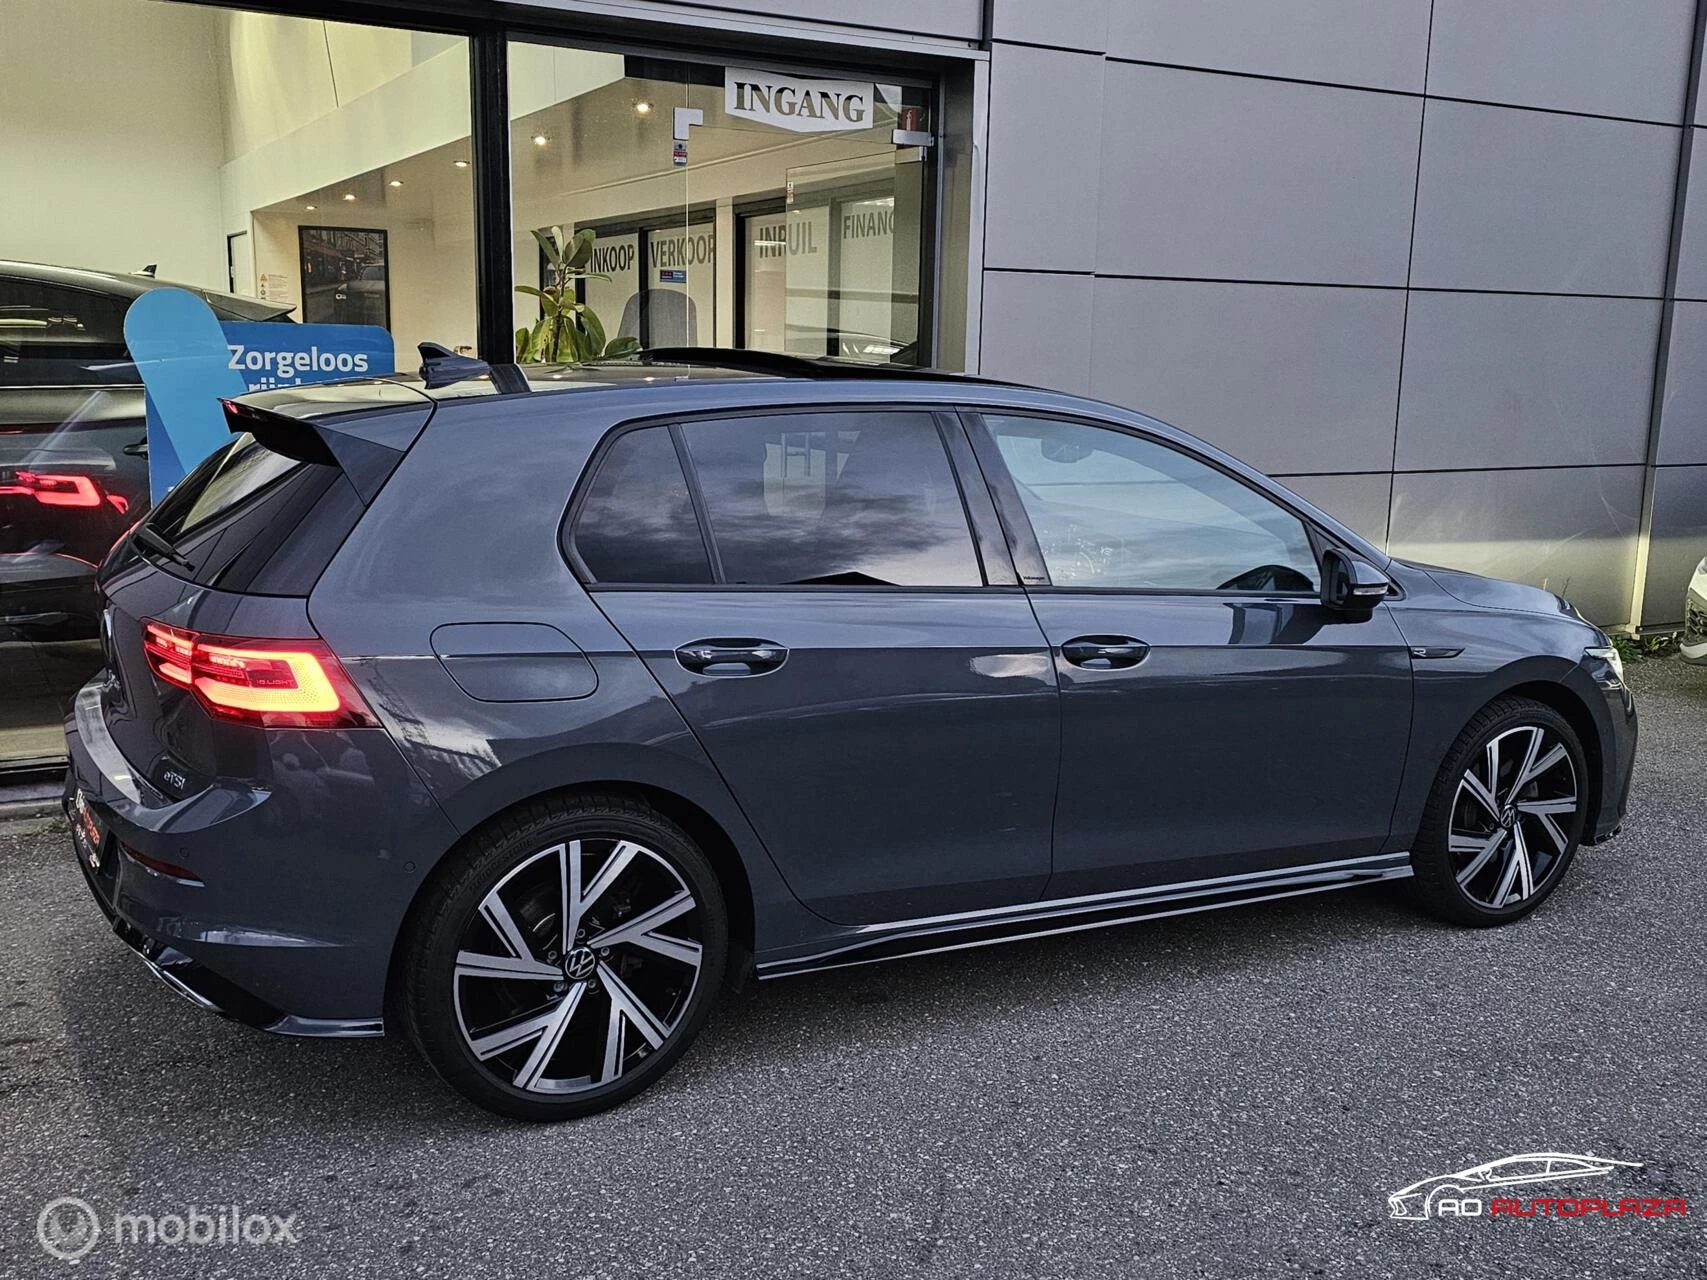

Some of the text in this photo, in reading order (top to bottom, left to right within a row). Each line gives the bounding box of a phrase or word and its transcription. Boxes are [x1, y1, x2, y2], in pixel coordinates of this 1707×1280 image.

[734, 81, 865, 123] INGANG
[759, 221, 818, 259] INRUIL
[227, 344, 369, 378] Zorgeloos
